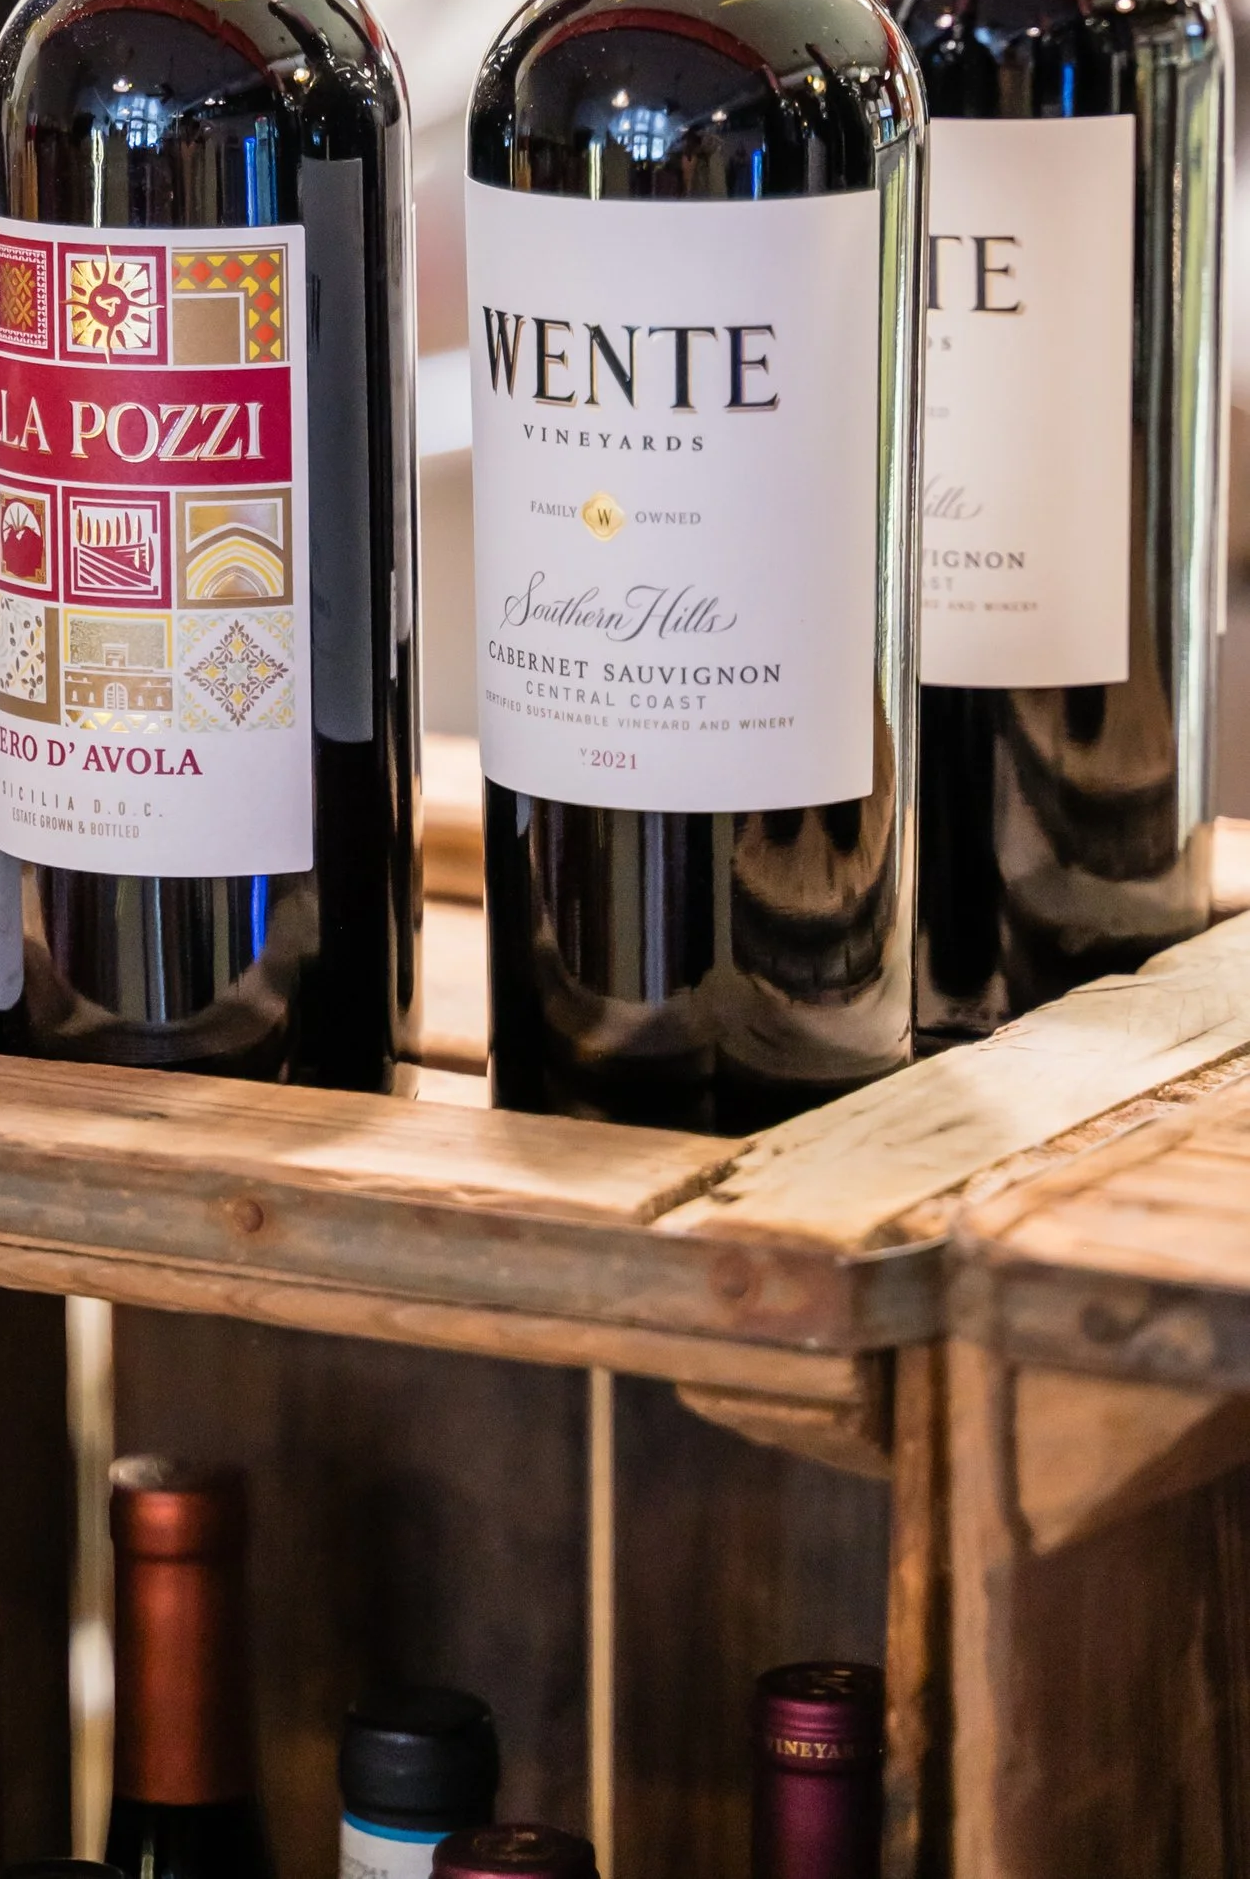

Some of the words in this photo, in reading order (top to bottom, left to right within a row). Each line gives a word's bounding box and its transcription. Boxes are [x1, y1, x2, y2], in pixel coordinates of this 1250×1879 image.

[483, 306, 780, 413] WENTE
[69, 400, 265, 463] POZZI
[524, 424, 704, 451] VINEYARDS
[530, 500, 578, 519] FAMILY
[635, 510, 702, 525] OWNED
[924, 473, 984, 520] ills
[923, 548, 1025, 569] IGNON
[500, 571, 632, 630] Southern
[605, 584, 738, 642] Hills
[489, 640, 589, 679] CABERNET
[603, 663, 782, 686] SAUVIGNON
[526, 680, 616, 707] CENTRAL
[630, 694, 708, 710] COAST
[526, 704, 609, 728] SUSTAINABLE
[617, 717, 690, 731] VINEYARD
[699, 720, 731, 731] AND
[739, 716, 796, 731] WINERY
[590, 749, 639, 770] 2021
[2, 780, 75, 812] SICILIA
[12, 806, 37, 827] ESTATE
[40, 814, 74, 833] GROWN
[78, 820, 86, 835] &
[90, 821, 141, 839] BOTTLED
